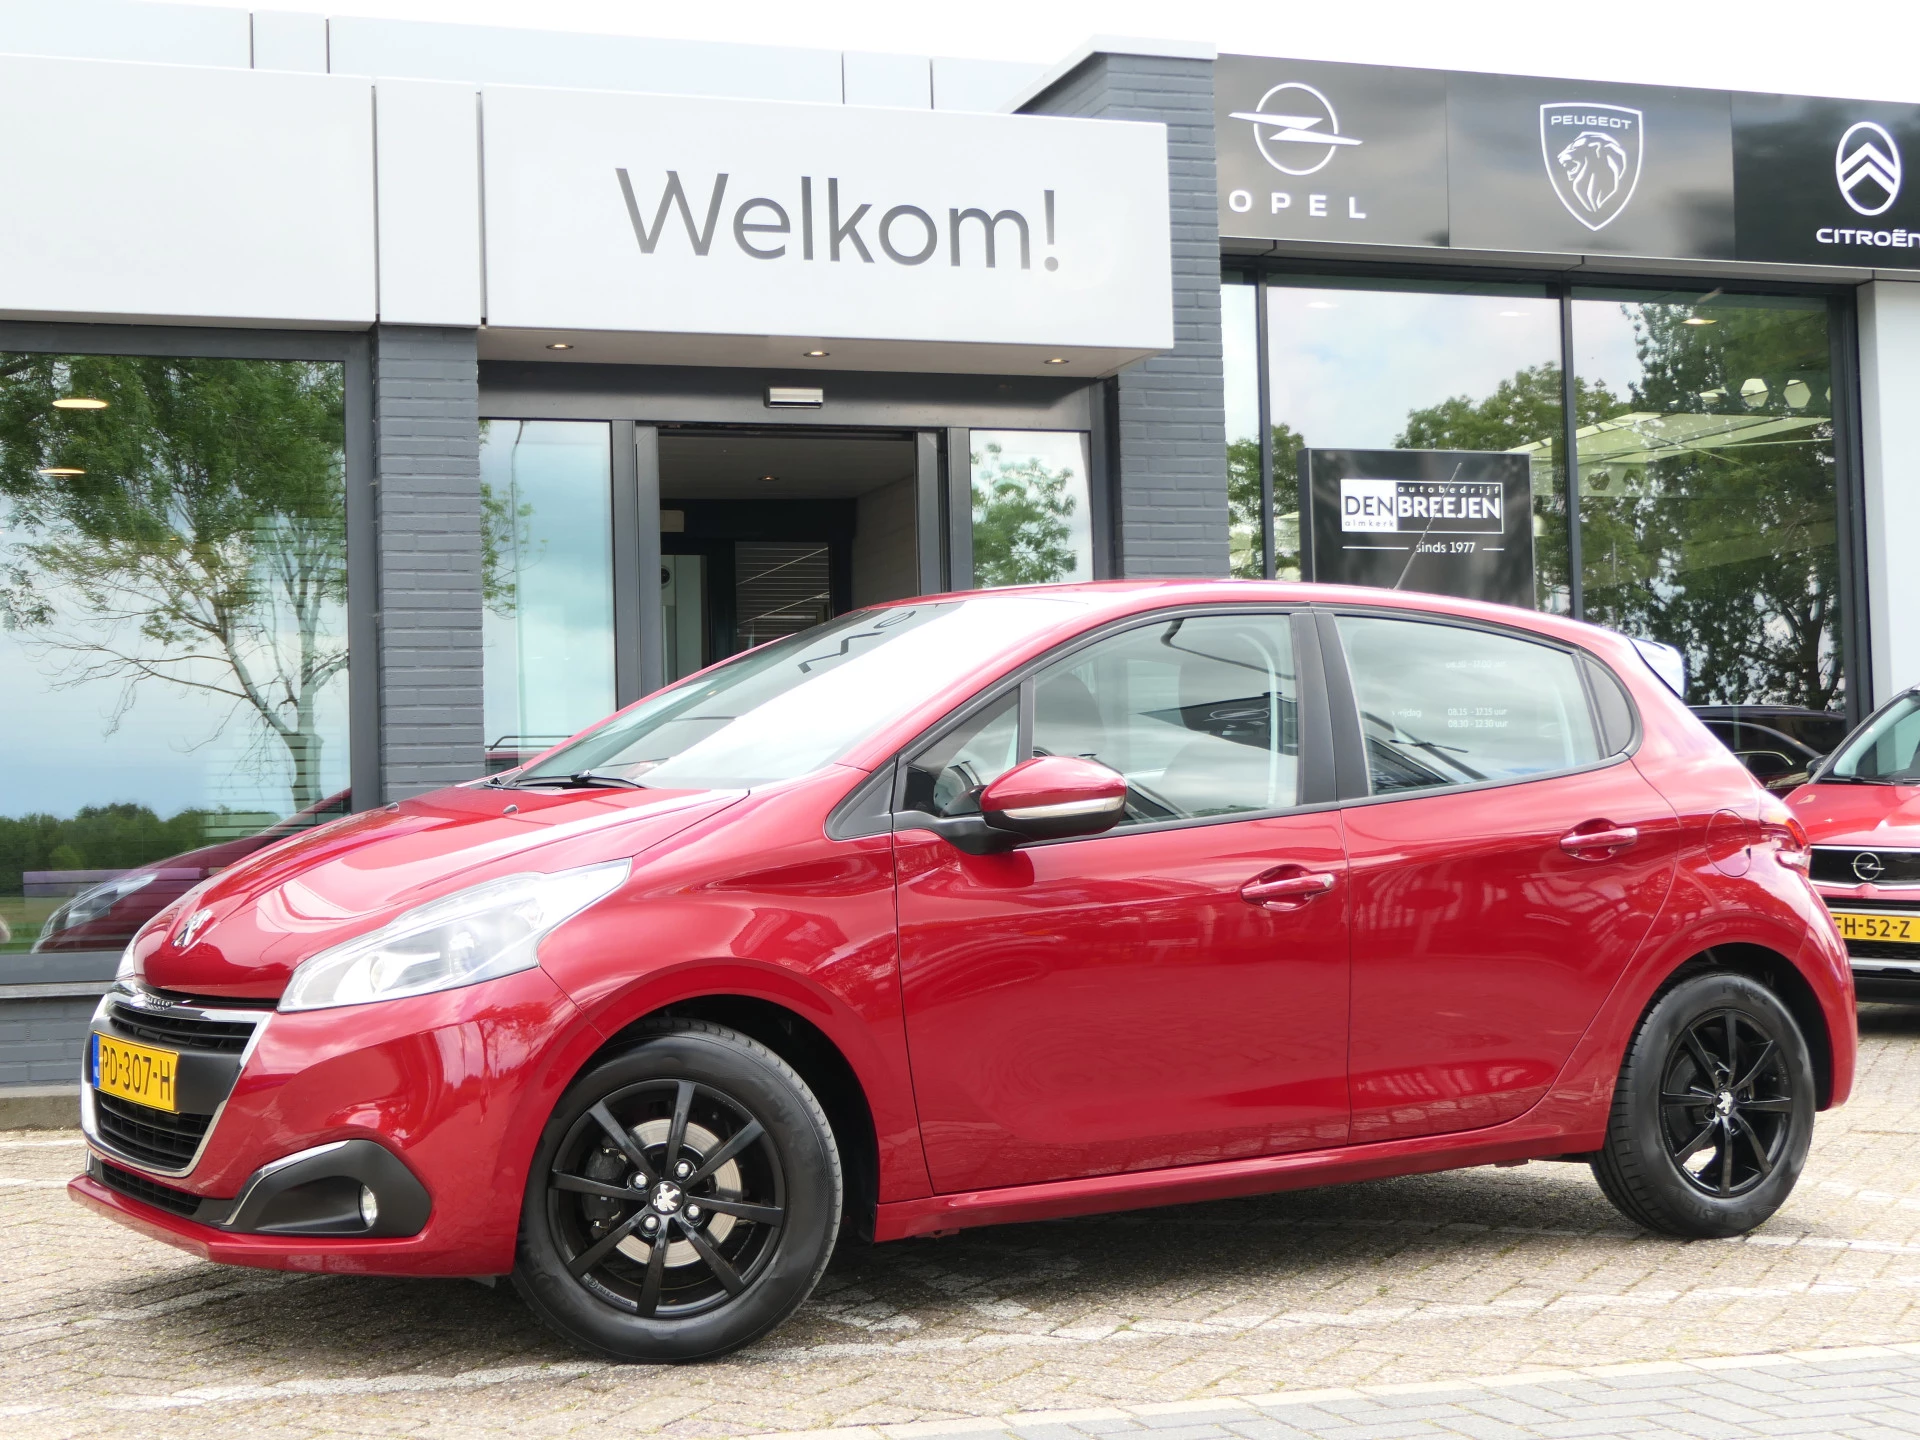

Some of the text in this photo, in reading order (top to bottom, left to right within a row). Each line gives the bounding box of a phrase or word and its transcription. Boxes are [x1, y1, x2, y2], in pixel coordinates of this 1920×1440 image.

[1551, 115, 1632, 130] PEUGEOT
[1228, 189, 1367, 219] OPEL
[615, 167, 1059, 273] Welkom!
[1397, 486, 1500, 496] autobedrijf
[1344, 495, 1500, 519] DEN BREEJEN
[1344, 519, 1394, 527] almkerk
[1416, 541, 1476, 554] sinds 1977
[102, 1044, 171, 1101] PD-307-H
